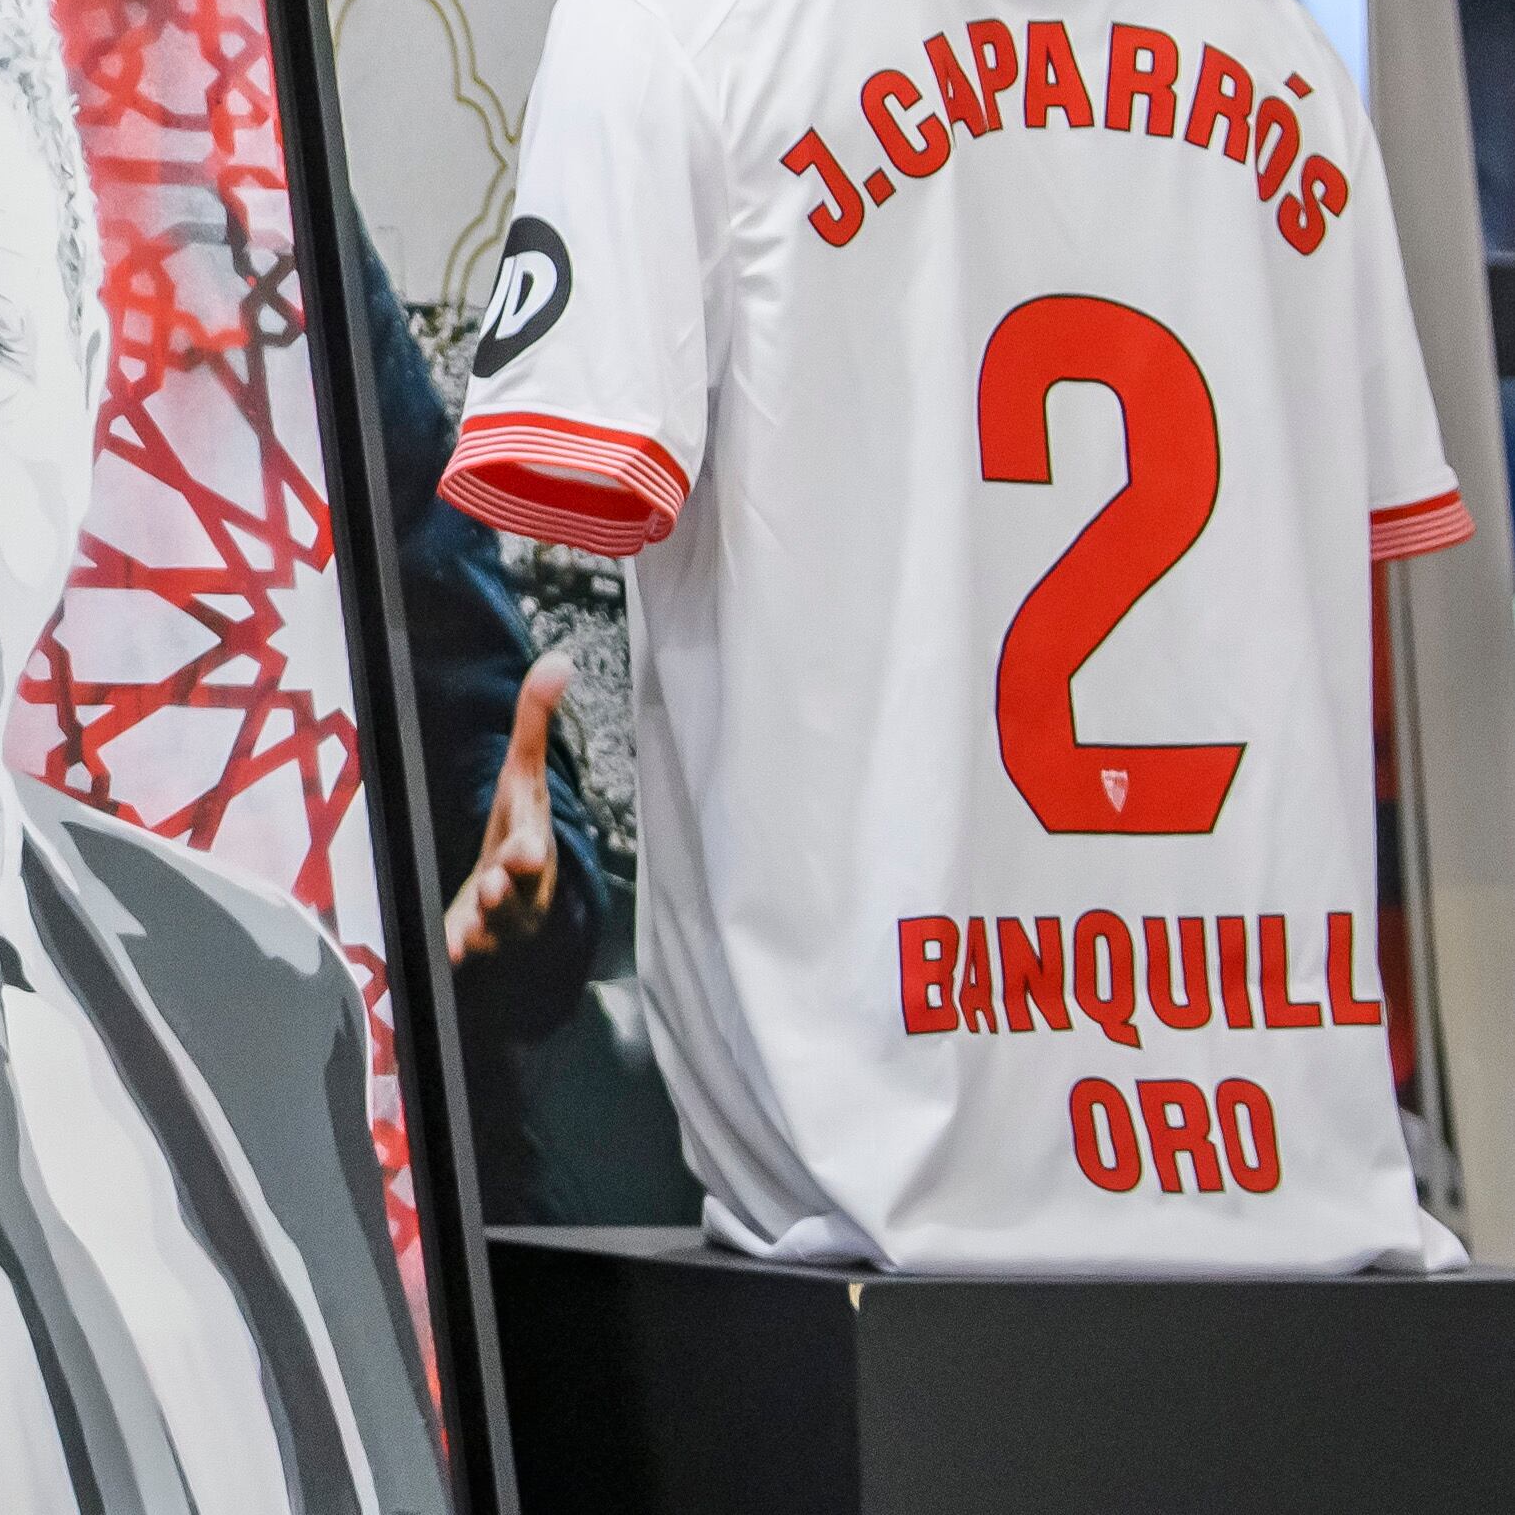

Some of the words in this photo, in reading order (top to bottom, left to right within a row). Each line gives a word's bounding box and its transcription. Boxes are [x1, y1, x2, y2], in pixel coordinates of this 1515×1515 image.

[779, 17, 1349, 256] J.CAPARRÓS
[977, 293, 1249, 835] 2
[1068, 1075, 1281, 1195] ORO
